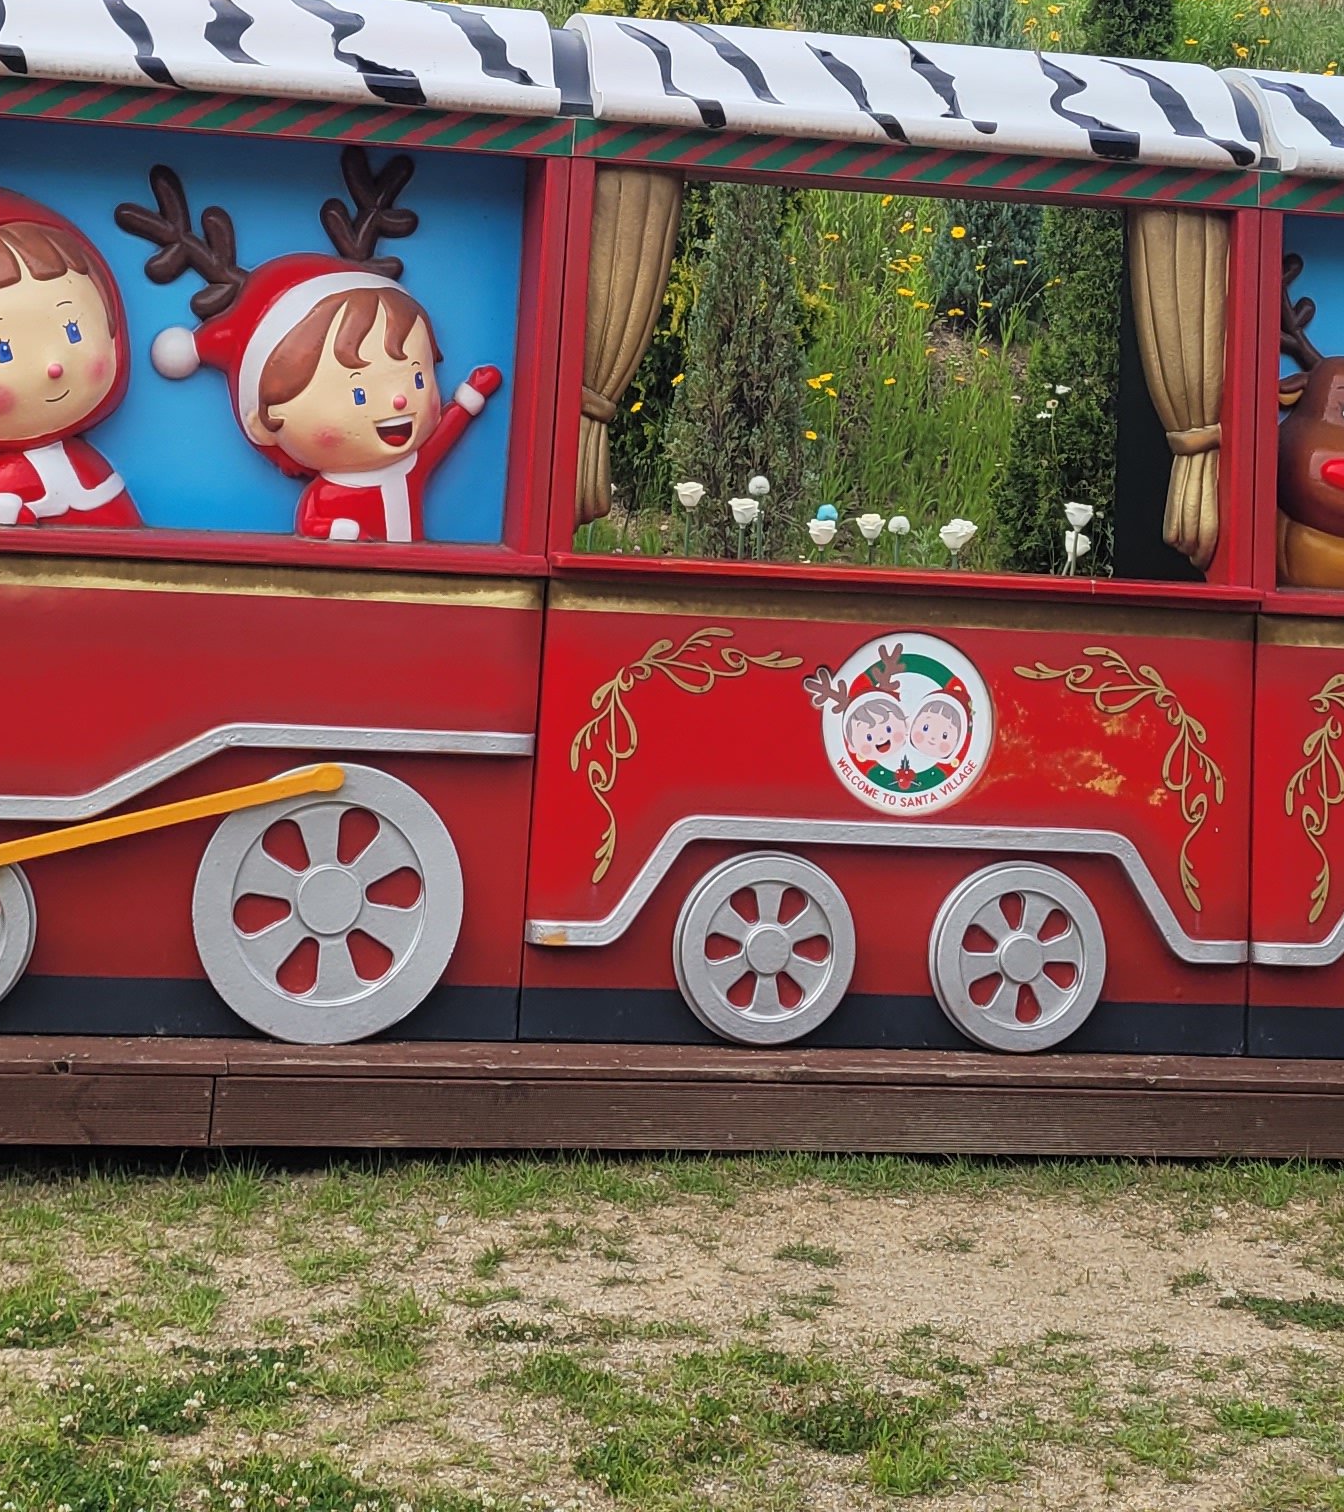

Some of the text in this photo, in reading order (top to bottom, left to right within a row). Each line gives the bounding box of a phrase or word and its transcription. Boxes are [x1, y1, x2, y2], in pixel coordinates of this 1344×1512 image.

[836, 756, 978, 808] WELCOME TO SANTA VILLAGE
